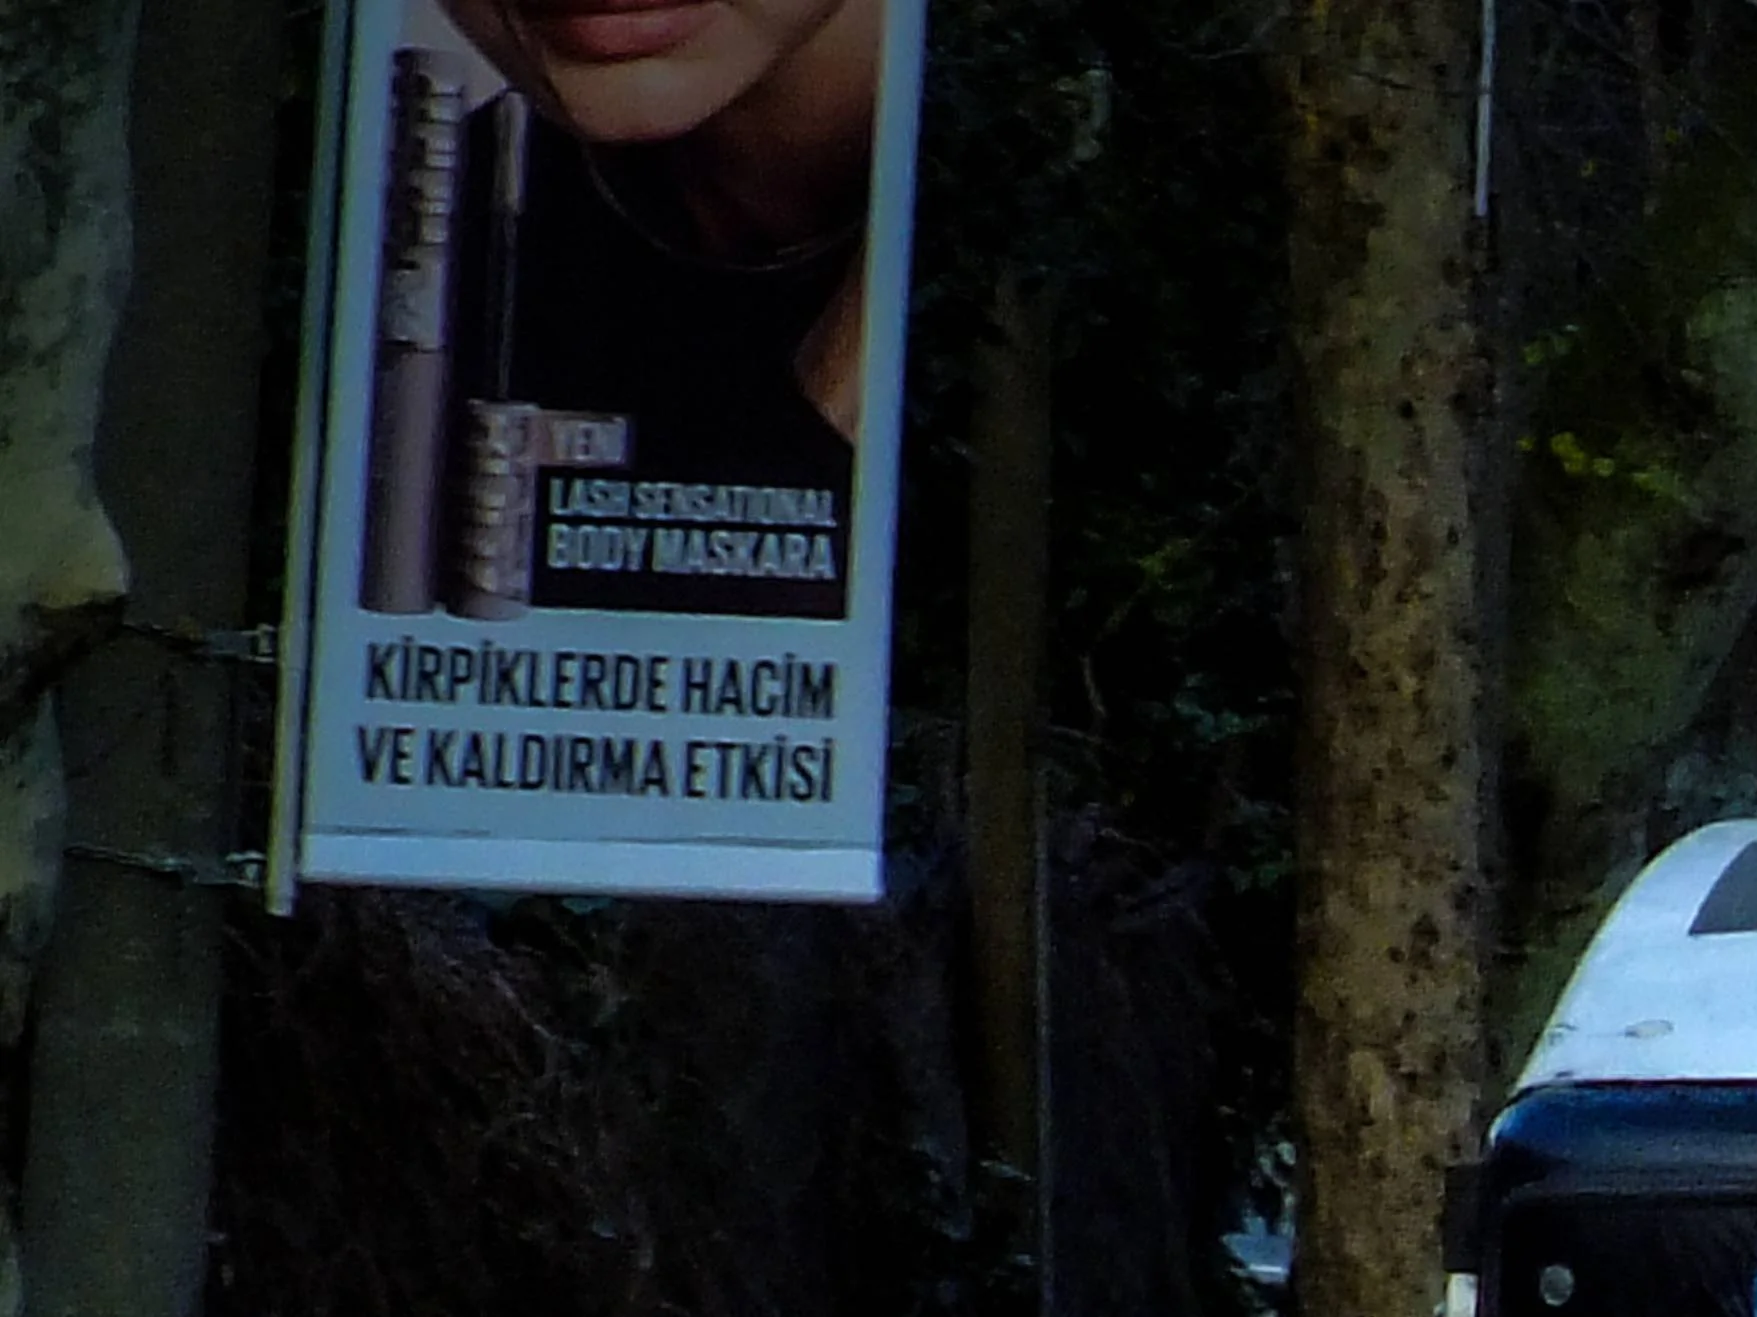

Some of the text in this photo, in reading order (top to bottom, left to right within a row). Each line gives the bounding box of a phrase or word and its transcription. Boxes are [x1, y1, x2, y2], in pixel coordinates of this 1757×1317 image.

[547, 523, 837, 580] BODY MASKARA
[365, 635, 836, 719] KİRPİKLERDE HACİM
[357, 725, 836, 802] VE KALDIRMA ETKİSİ
